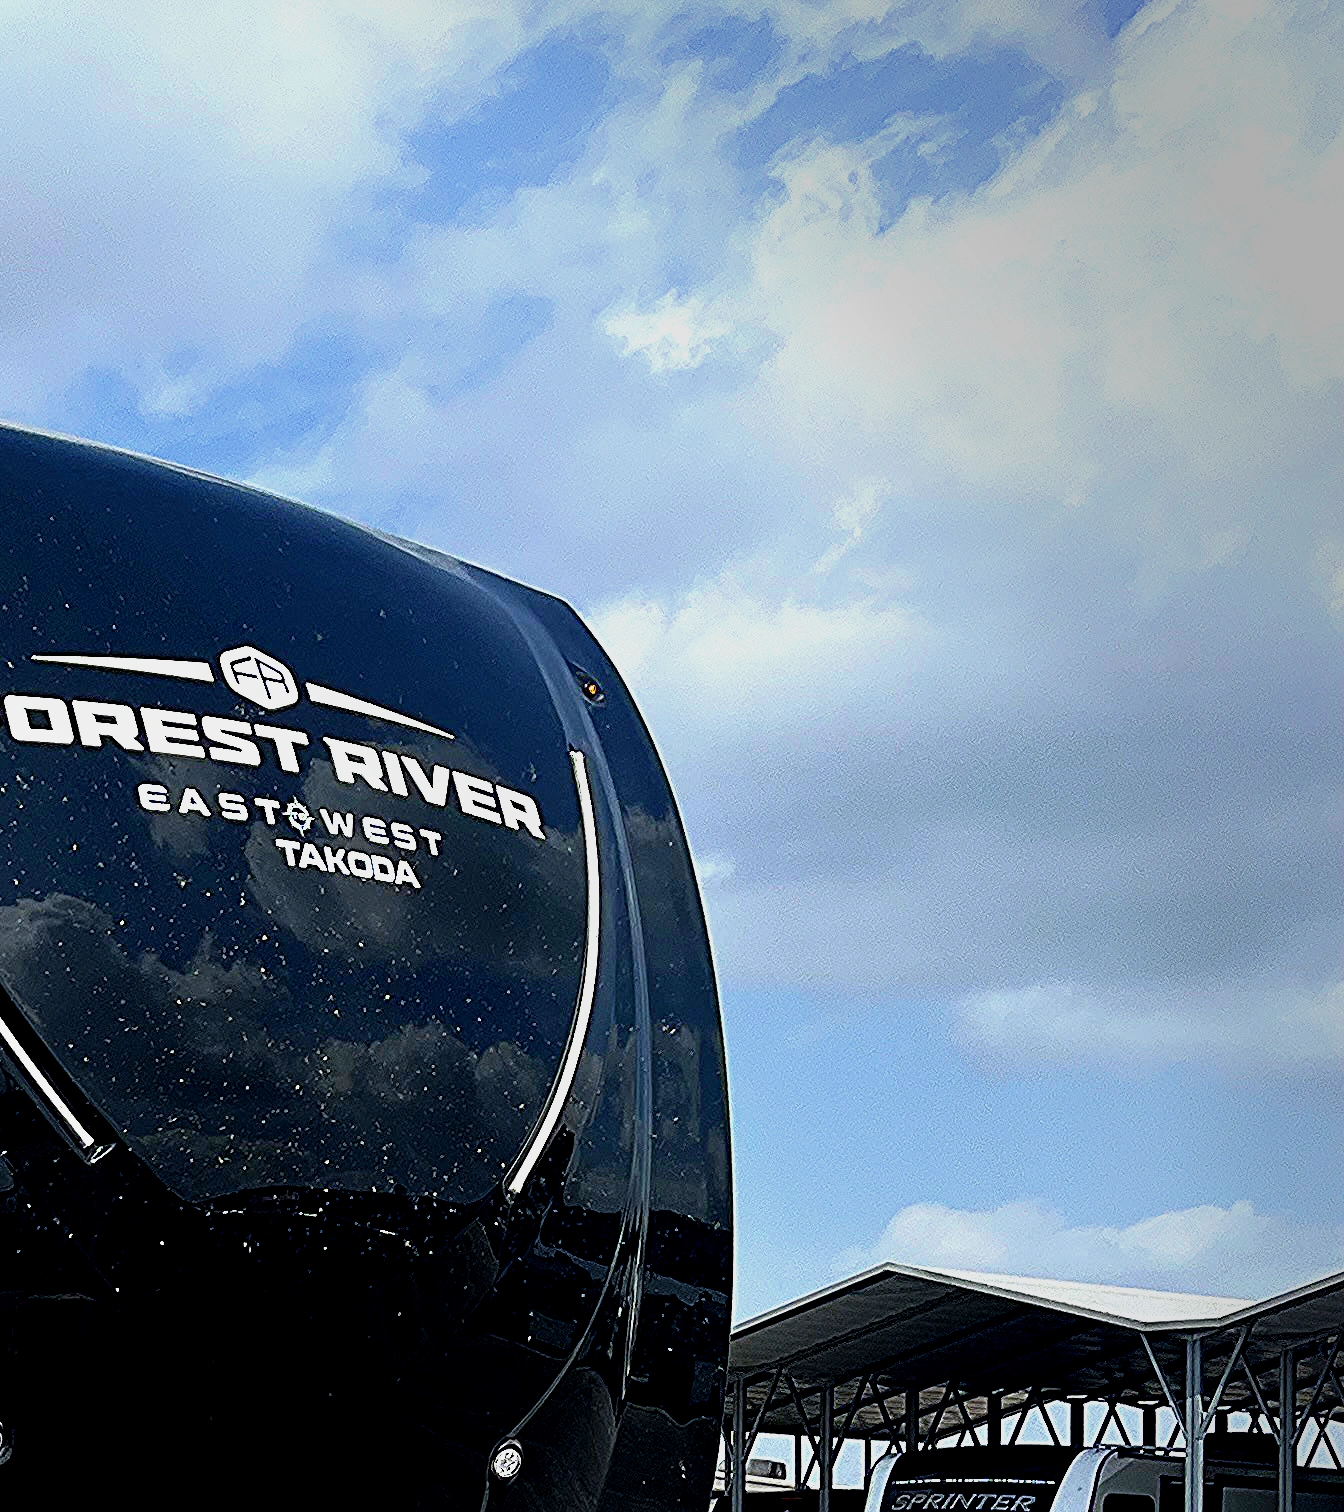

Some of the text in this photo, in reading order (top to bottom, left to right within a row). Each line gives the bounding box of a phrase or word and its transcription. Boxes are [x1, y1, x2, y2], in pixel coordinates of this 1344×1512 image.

[323, 736, 547, 839] RIVER
[137, 783, 443, 857] EAST WEST
[275, 838, 422, 889] TAKODA
[892, 1493, 1036, 1512] SPRINTER
